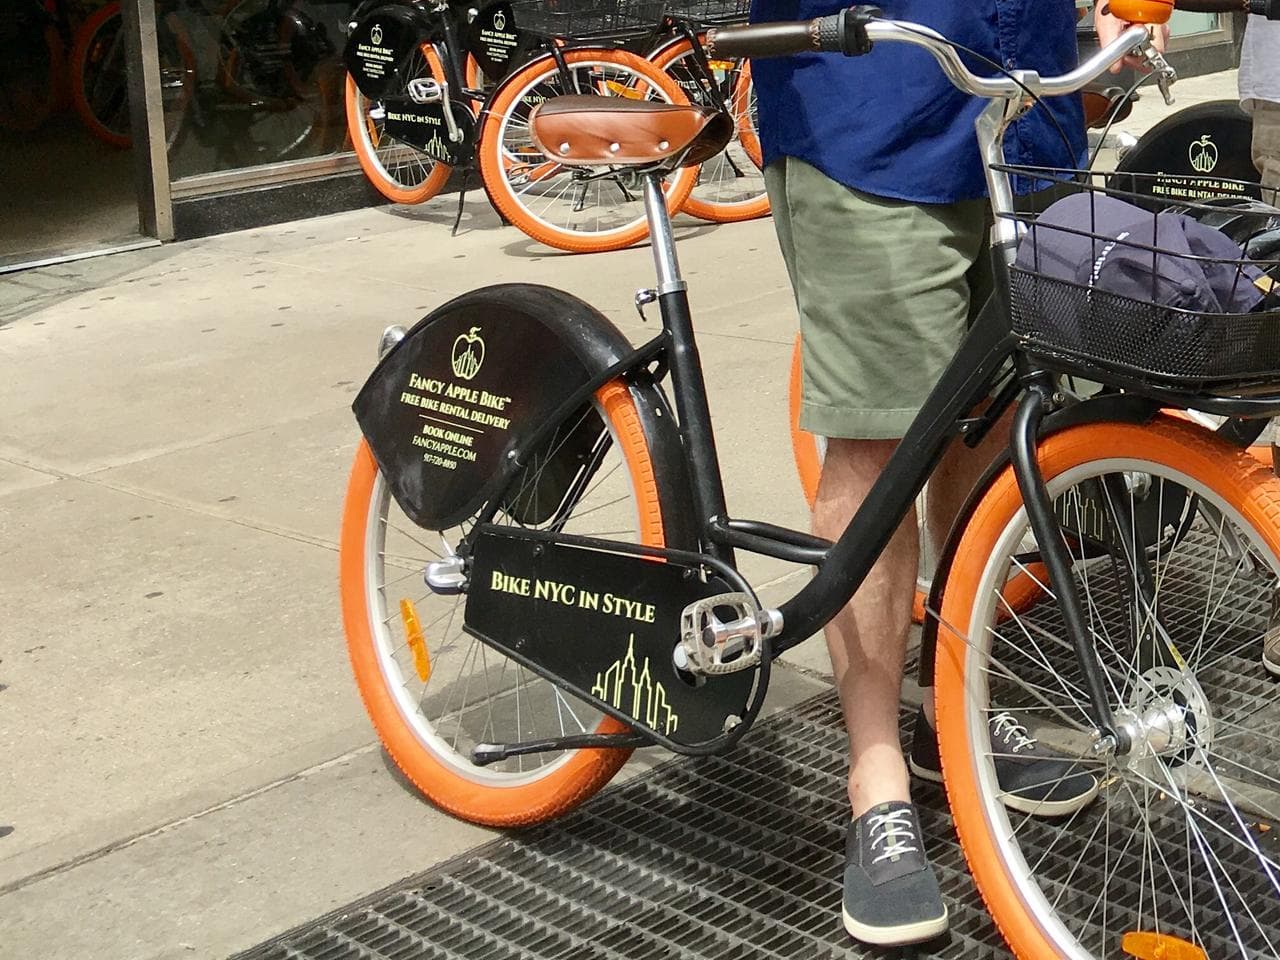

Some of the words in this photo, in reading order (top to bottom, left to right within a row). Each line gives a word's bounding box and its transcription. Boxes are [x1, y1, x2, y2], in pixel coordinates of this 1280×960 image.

[408, 372, 446, 394] FANCY
[444, 383, 479, 404] APPLE
[400, 392, 421, 407] FREE
[420, 397, 440, 411] BIKE
[439, 402, 470, 419] RENTAL
[470, 410, 511, 430] DELIVERY
[422, 424, 445, 436] BOOK
[444, 430, 474, 446] ONLINE
[490, 570, 531, 597] BIKE
[533, 578, 576, 606] NYC
[578, 590, 599, 611] IN
[602, 592, 656, 624] STYLE
